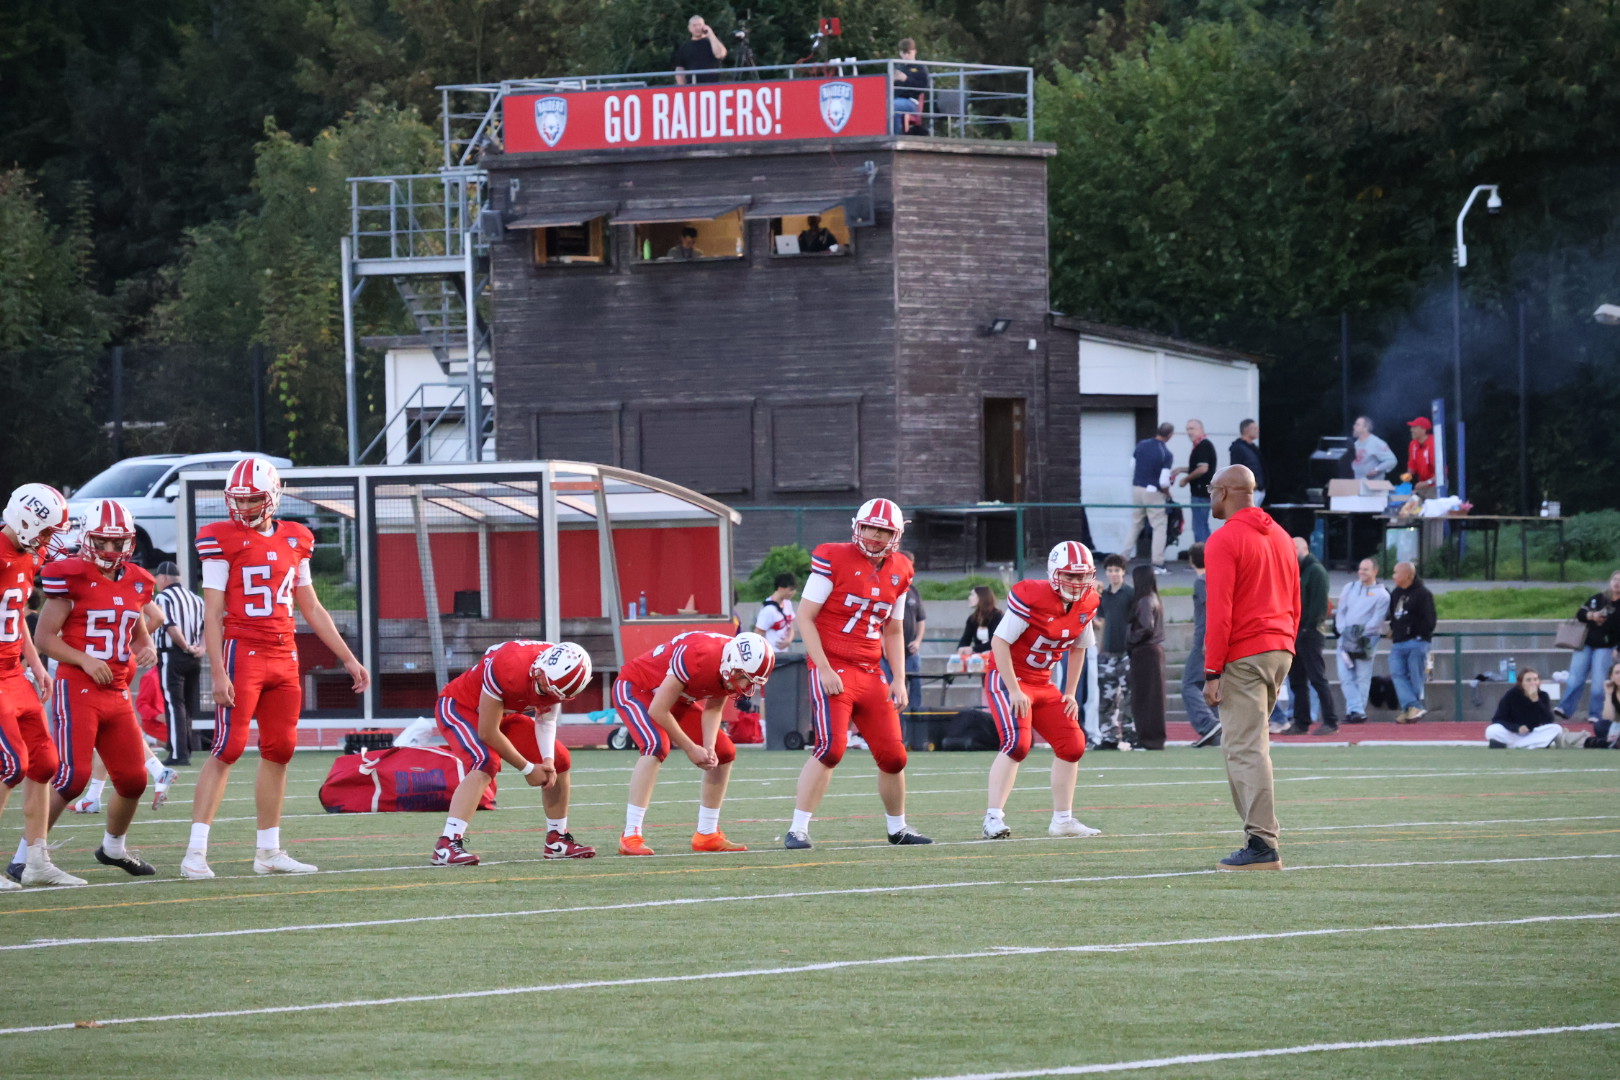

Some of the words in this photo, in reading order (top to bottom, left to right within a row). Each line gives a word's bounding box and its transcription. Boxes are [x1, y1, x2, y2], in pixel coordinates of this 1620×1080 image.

[604, 94, 641, 143] GO
[652, 87, 782, 140] RAIDERS!
[26, 496, 50, 519] ISB
[241, 565, 296, 618] 54
[841, 593, 893, 640] 72
[85, 608, 141, 662] 50
[740, 640, 752, 662] ISB
